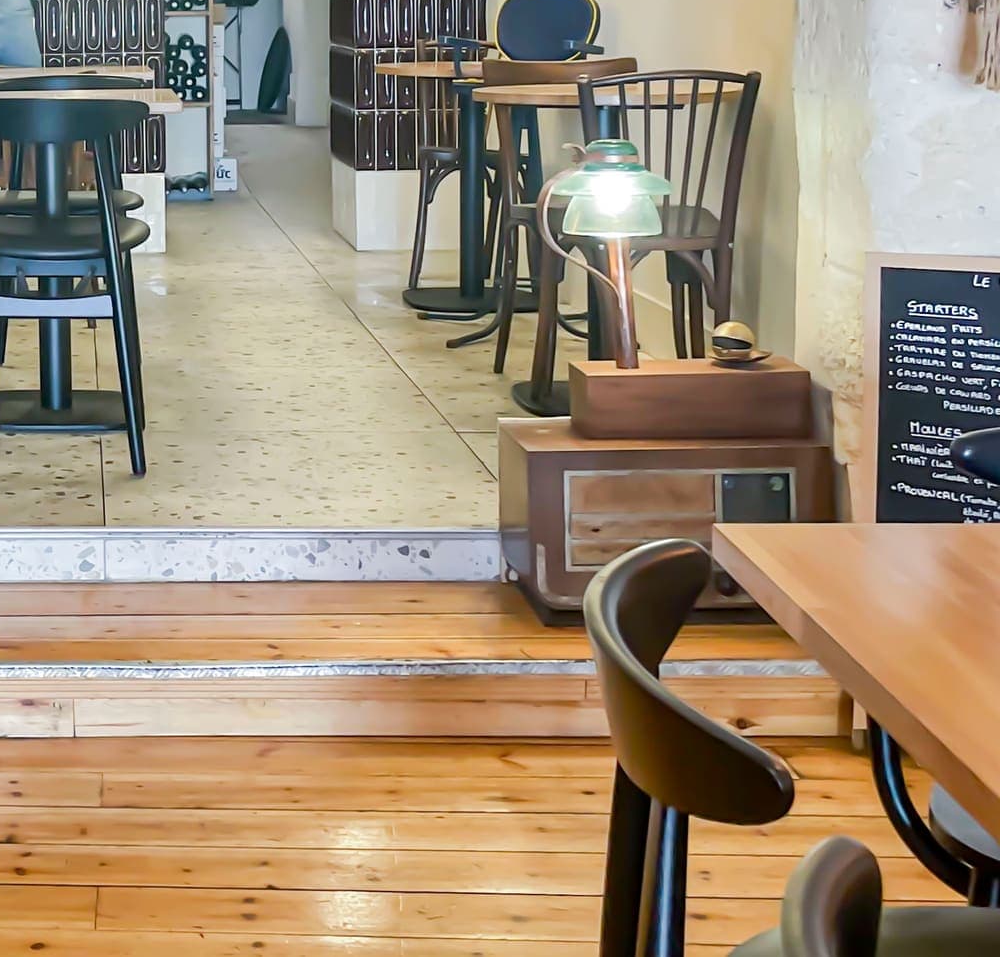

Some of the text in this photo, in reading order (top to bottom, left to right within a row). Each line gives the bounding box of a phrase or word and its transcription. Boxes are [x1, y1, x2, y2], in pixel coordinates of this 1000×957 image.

[973, 274, 991, 288] LE
[906, 300, 979, 320] STARTERS
[952, 323, 983, 334] FRITS
[894, 344, 947, 356] TARTARE
[951, 361, 964, 369] DE
[896, 368, 956, 383] GASPACHO
[949, 388, 992, 400] CANARD
[909, 421, 963, 440] MOULES
